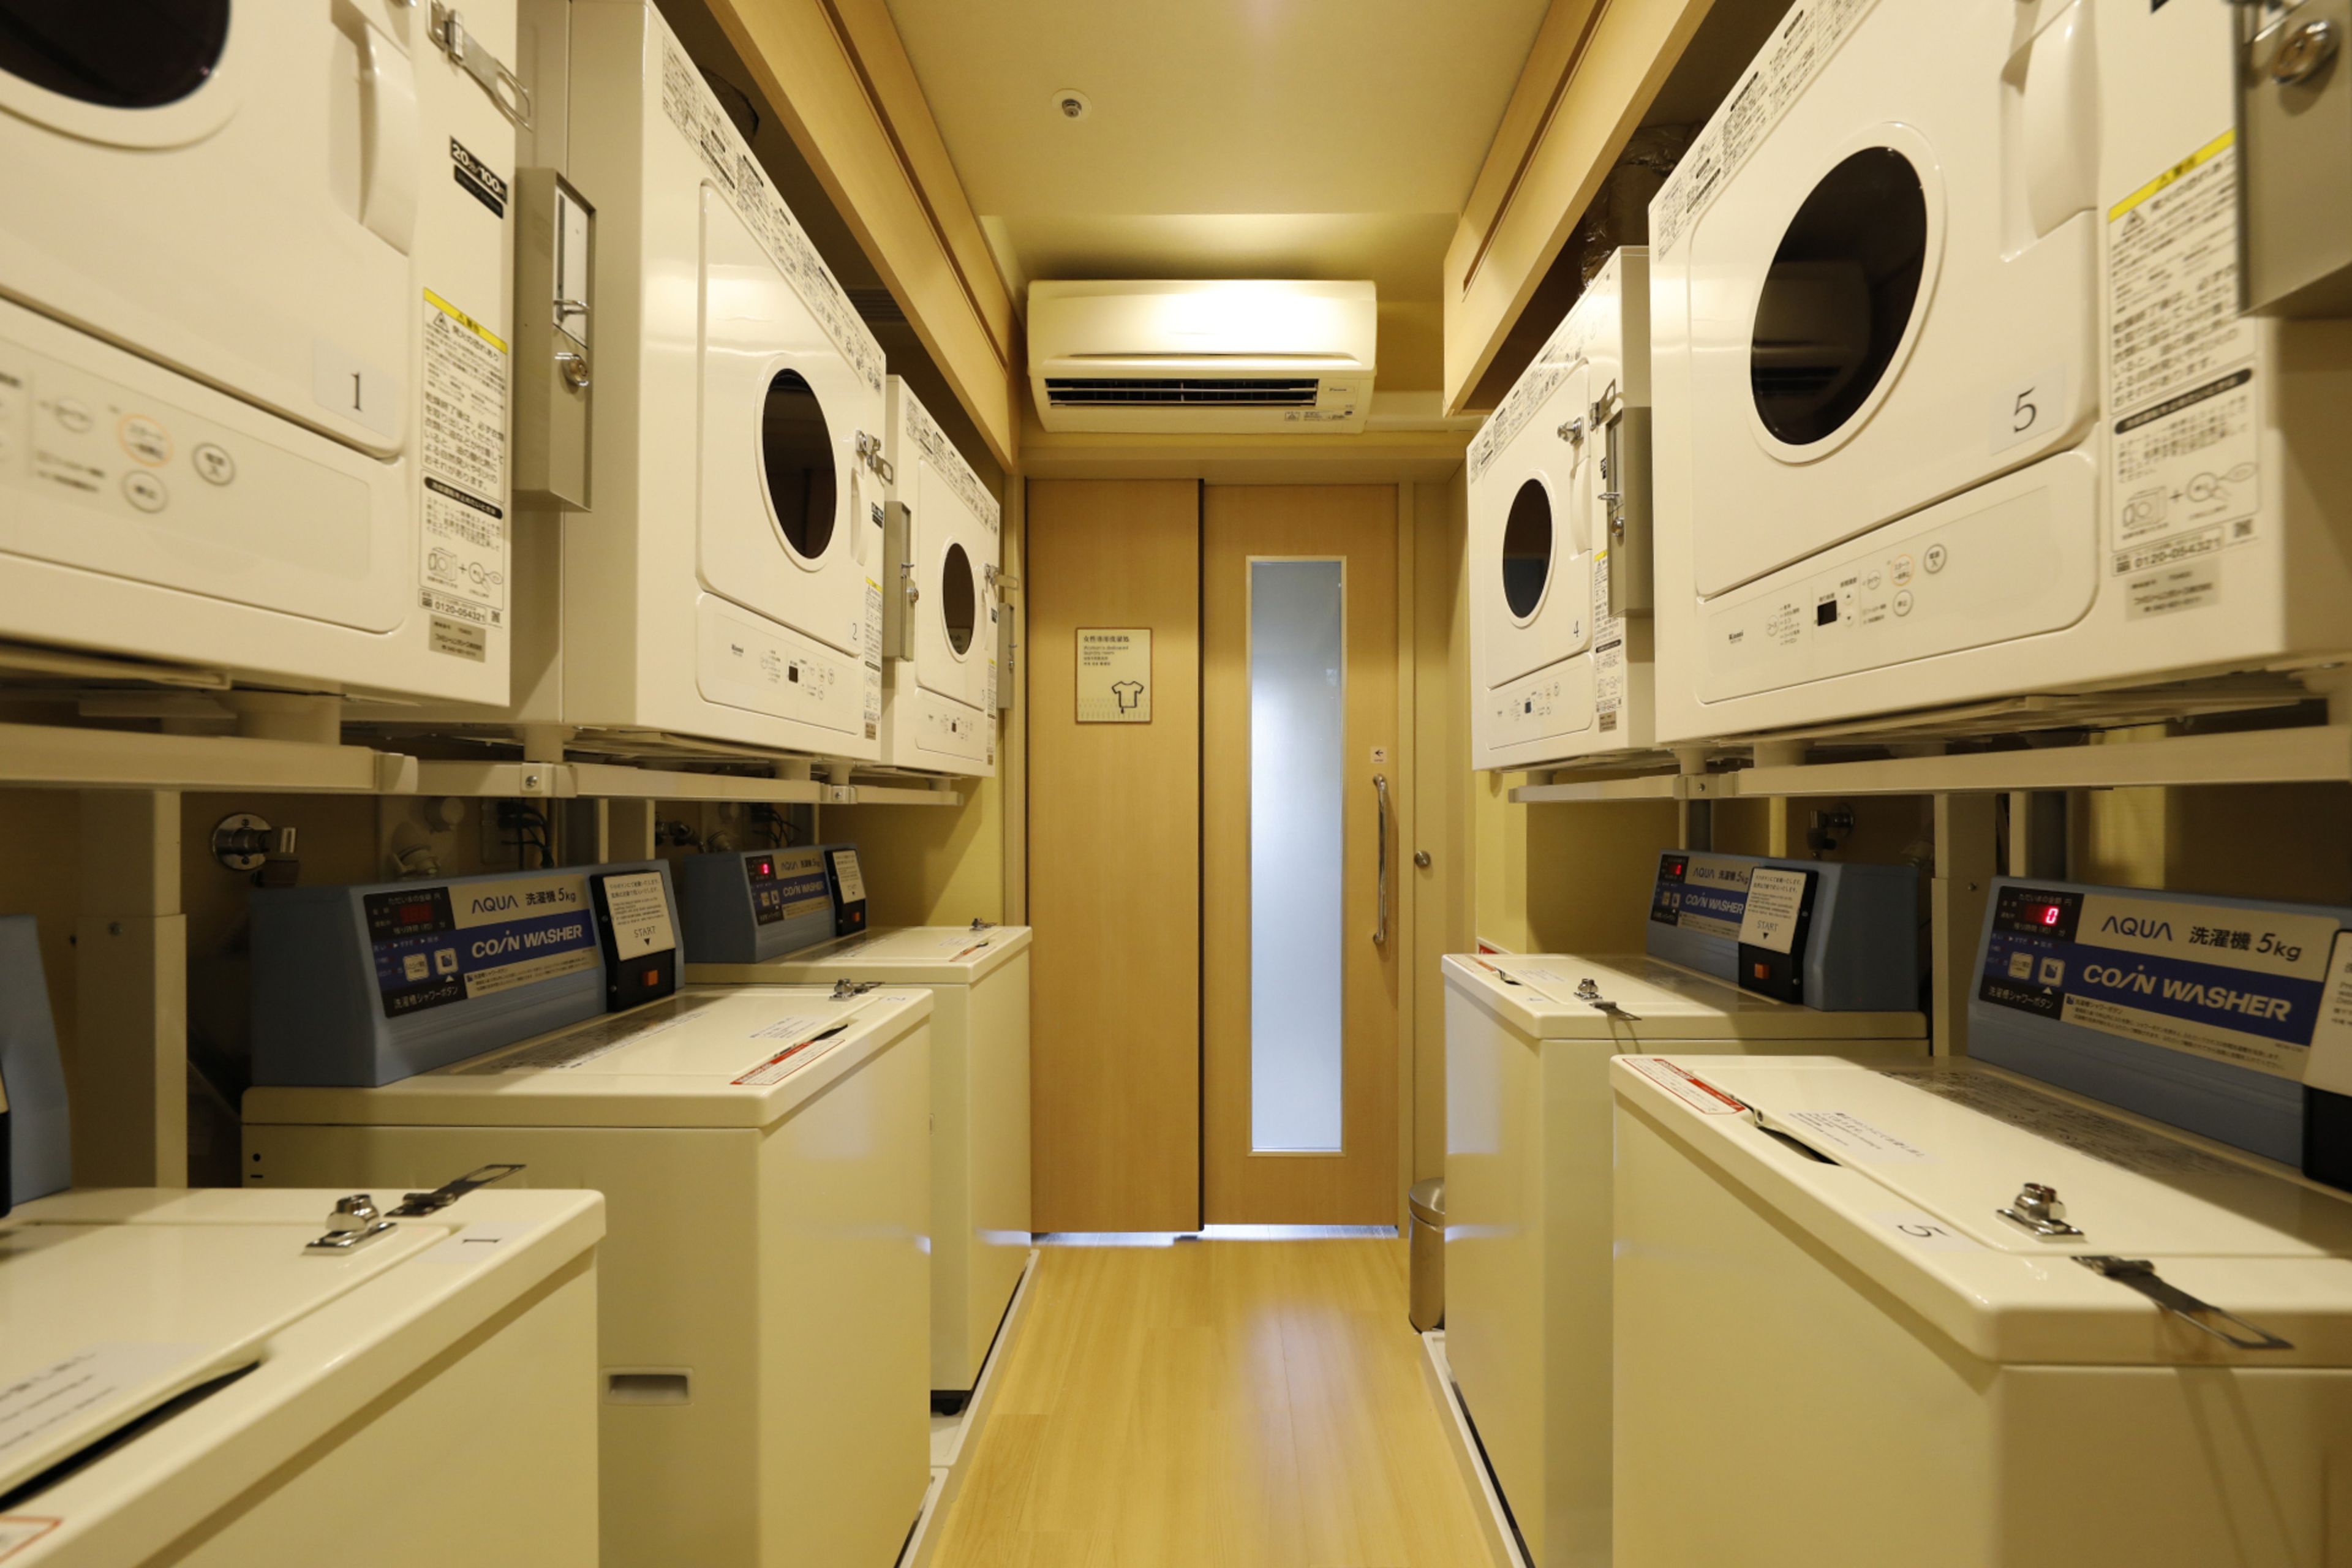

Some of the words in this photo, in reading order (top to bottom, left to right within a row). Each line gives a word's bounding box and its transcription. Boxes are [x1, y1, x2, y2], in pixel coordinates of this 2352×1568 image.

[352, 373, 361, 411] 1
[2012, 388, 2037, 433] 5
[852, 622, 858, 641] 2
[1574, 620, 1580, 638] 4
[472, 894, 519, 914] AQUA
[525, 891, 556, 907] 洗濯機
[557, 887, 577, 903] 5kg
[1708, 900, 1744, 915] WASHER
[2045, 907, 2059, 925] 0
[633, 925, 656, 938] START
[1757, 920, 1779, 932] START
[471, 929, 520, 959] COIN
[524, 923, 583, 948] WASHER
[2101, 916, 2173, 941] AQUA
[2188, 925, 2252, 951] 洗濯機
[2256, 932, 2302, 962] 5kg
[2083, 964, 2157, 995] COIN
[2162, 978, 2292, 1022] WASHER
[1896, 1224, 1951, 1238] 5
